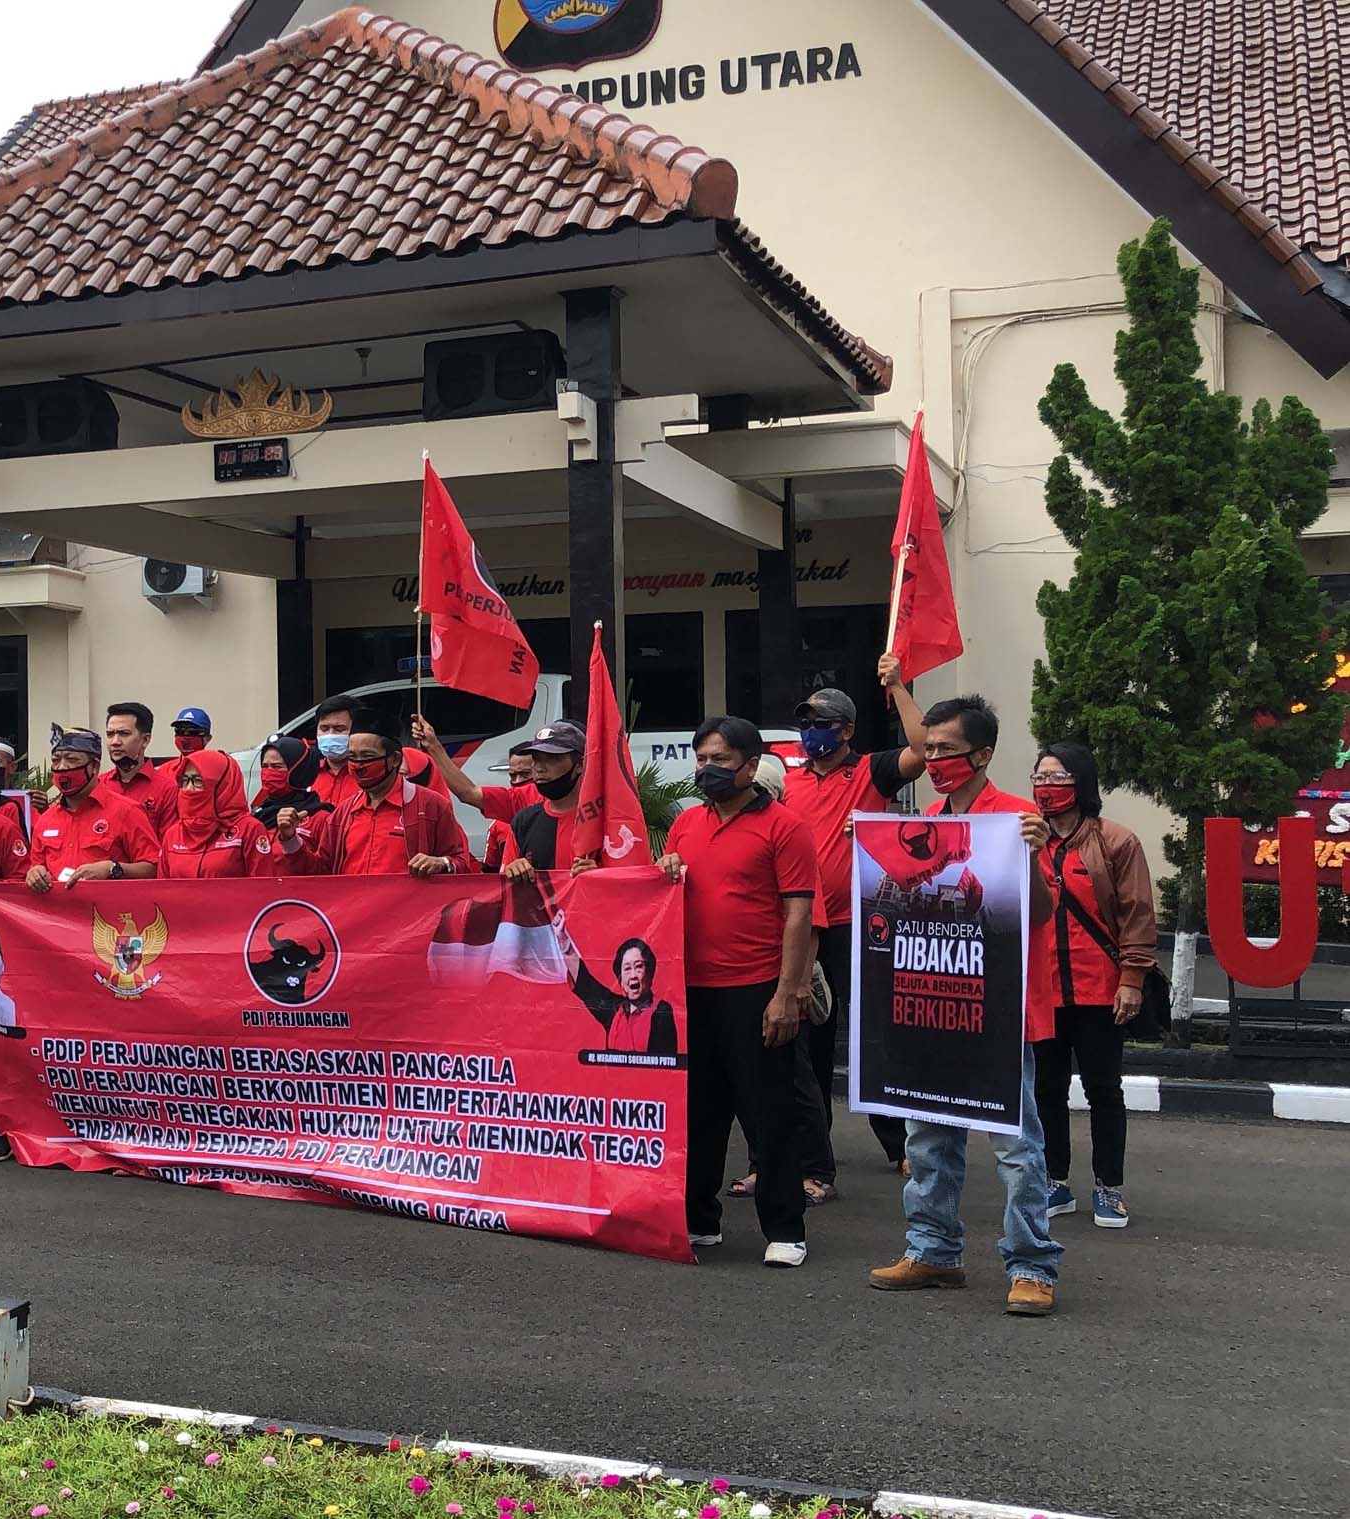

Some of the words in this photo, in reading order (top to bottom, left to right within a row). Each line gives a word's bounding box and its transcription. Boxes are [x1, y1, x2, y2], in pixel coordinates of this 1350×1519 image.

[561, 64, 705, 110] MPUNG
[720, 42, 862, 95] UTARA
[896, 920, 924, 935] SATU
[928, 922, 984, 938] BENDERA
[893, 935, 984, 976] DIBAKAR
[895, 975, 929, 990] SEJUTA
[932, 980, 983, 995] BENDERA
[242, 1010, 264, 1027] PDI
[266, 1010, 350, 1028] PERJUANGAN
[893, 995, 983, 1033] BERKIBAR
[42, 1038, 85, 1063] PDIP
[91, 1041, 227, 1071] PERJUANGAN
[231, 1047, 385, 1077] BERASASKAN
[390, 1051, 516, 1086] PANCASILA
[47, 1067, 79, 1090] PDI
[82, 1070, 218, 1099] PERJUANGAN
[222, 1076, 387, 1108] BERKOMITMEN
[394, 1084, 605, 1127] MEMPERTAHANKAN
[610, 1099, 666, 1132] NKRI
[53, 1093, 161, 1122] MENUNTUT
[165, 1100, 295, 1134] PENEGAKAN
[299, 1111, 382, 1141] HUKUM
[386, 1117, 464, 1147] UNTUK
[467, 1122, 587, 1160] MENINDAK
[590, 1133, 665, 1168] TEGAS
[63, 1117, 191, 1150] PEMBAKARAN
[194, 1131, 289, 1158] BENDERA
[291, 1140, 325, 1164] PDI
[329, 1144, 482, 1184] PERJUANGAN
[434, 1203, 510, 1232] UTARA
